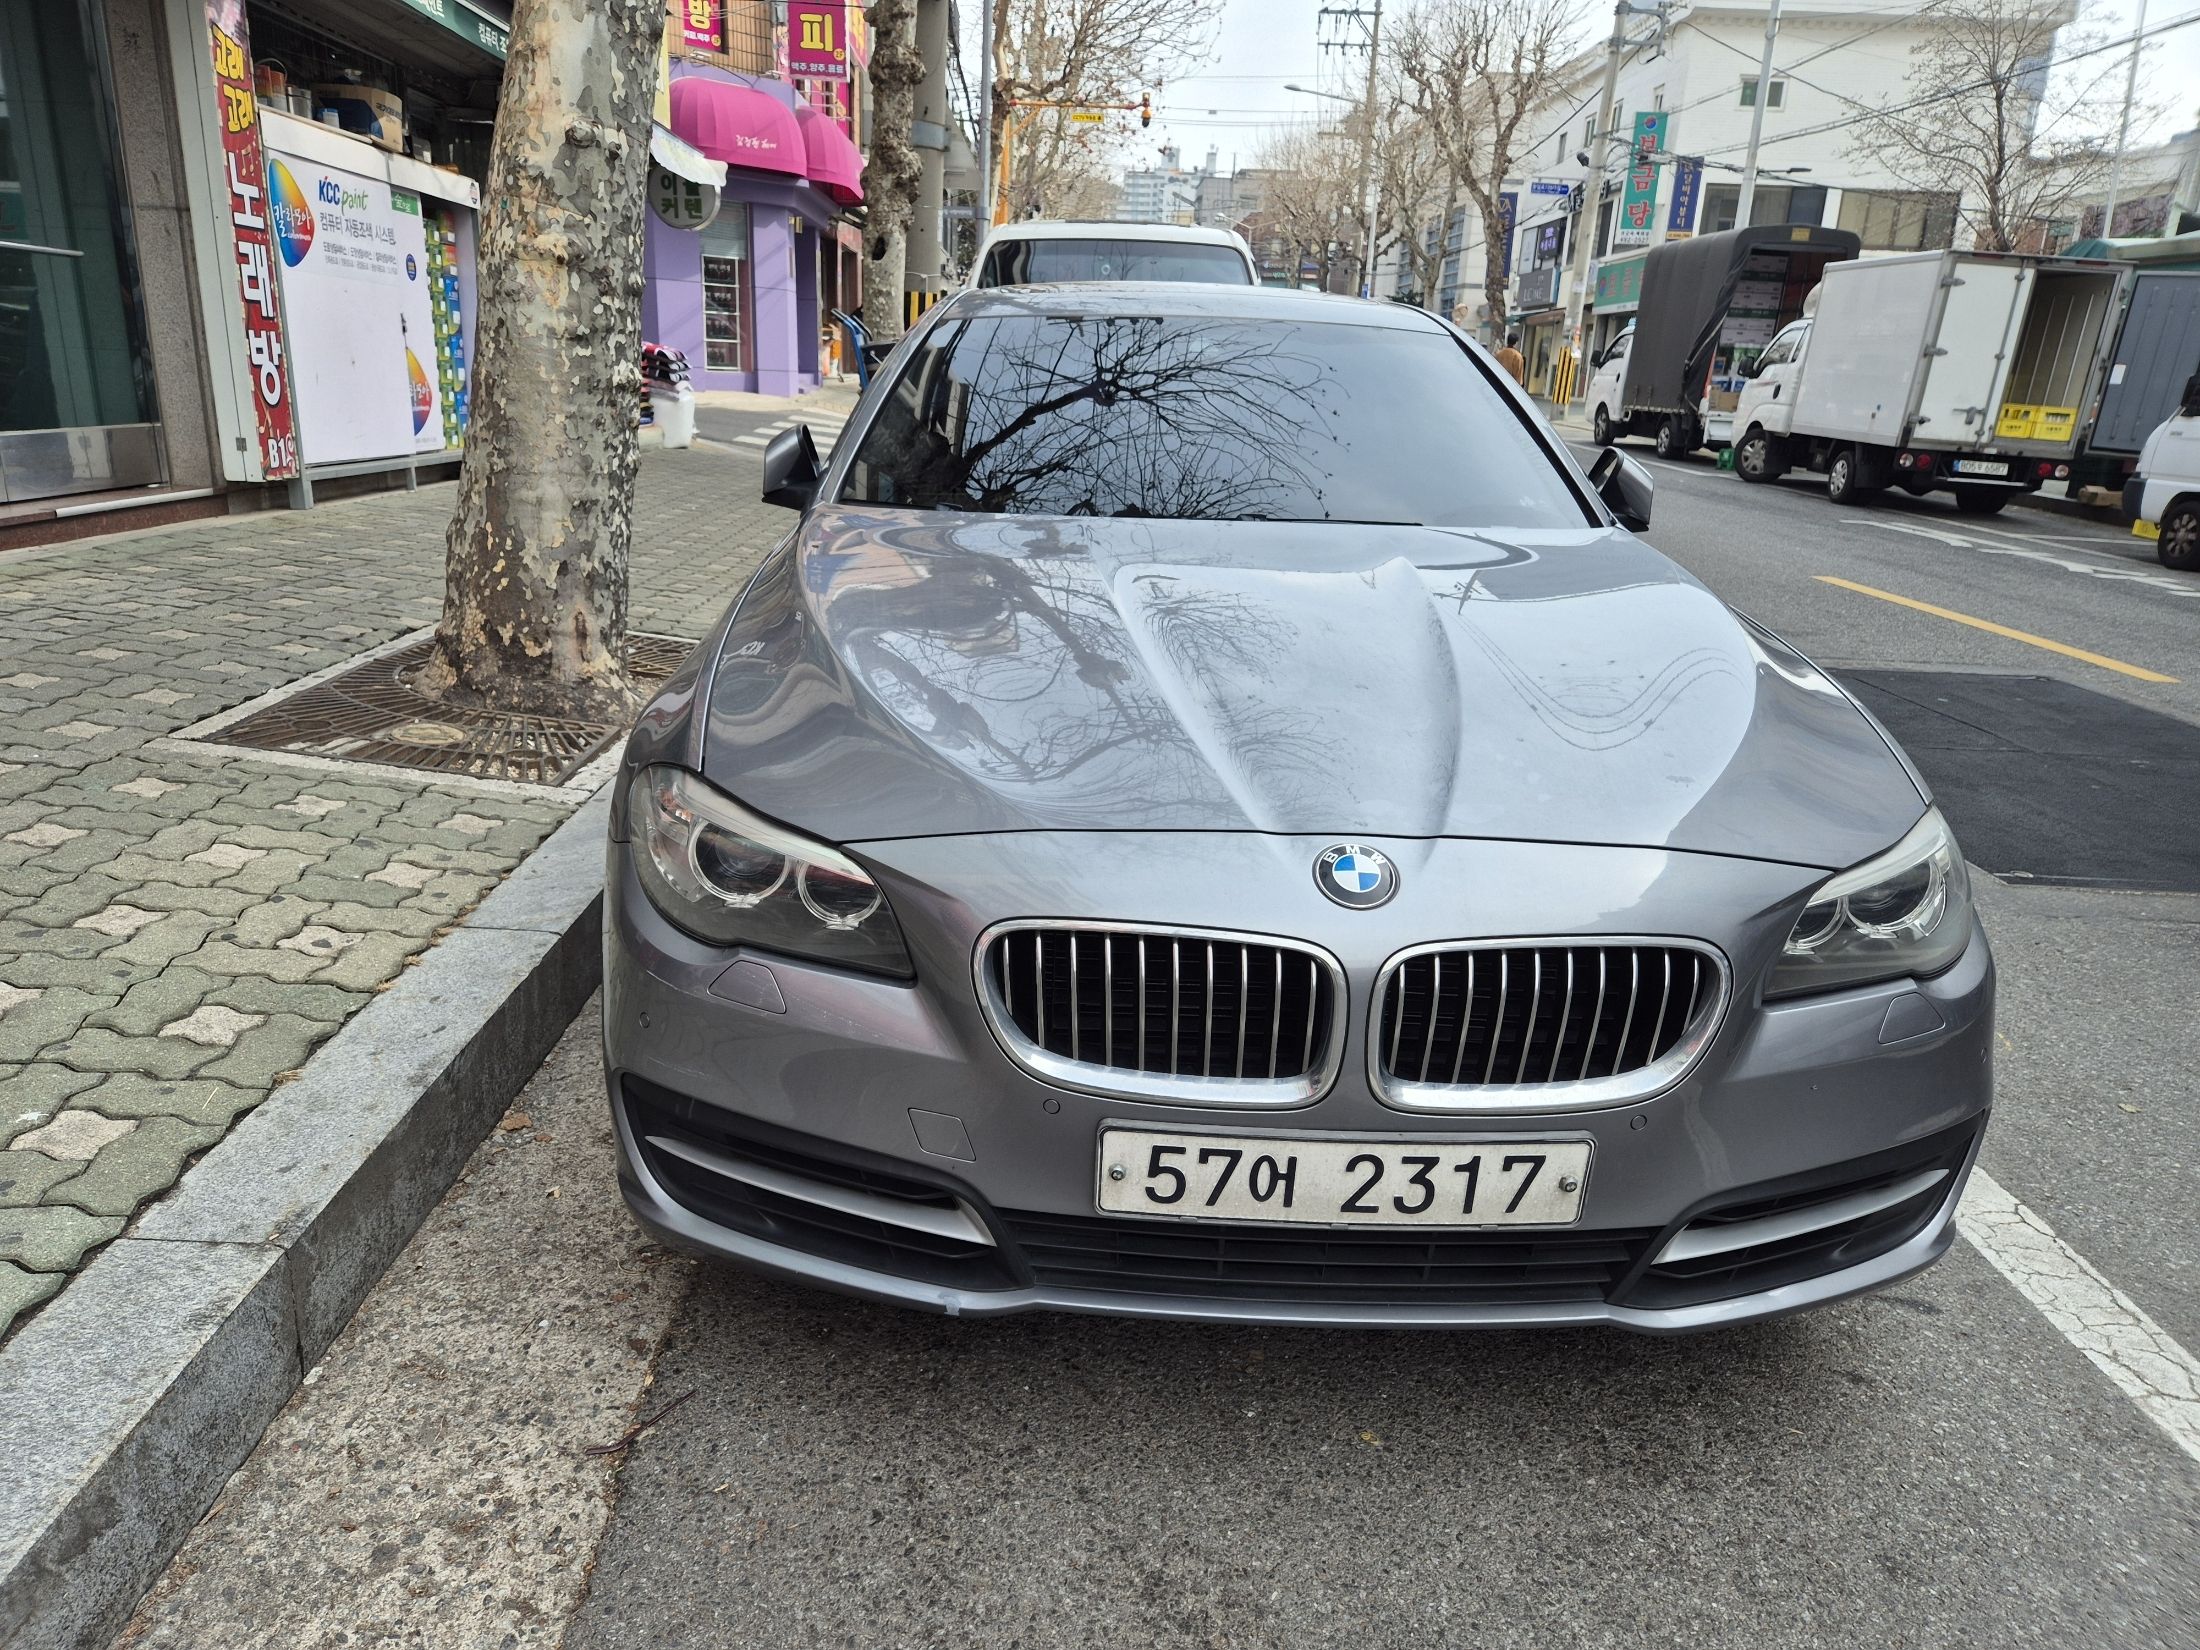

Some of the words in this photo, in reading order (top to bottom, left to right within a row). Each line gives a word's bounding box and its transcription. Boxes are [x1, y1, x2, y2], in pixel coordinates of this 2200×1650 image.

[211, 22, 245, 81] 고래
[800, 13, 833, 52] 피
[223, 84, 254, 132] 고래
[318, 176, 340, 206] KCC
[341, 189, 368, 217] paint
[320, 211, 344, 235] 컴퓨터
[344, 217, 374, 241] 자동조색
[374, 224, 397, 247] 시스템
[228, 151, 282, 405] 노래방
[268, 437, 287, 469] B1
[1323, 845, 1386, 865] BMW
[1145, 1144, 1298, 1208] 57어
[1340, 1153, 1547, 1215] 2317
